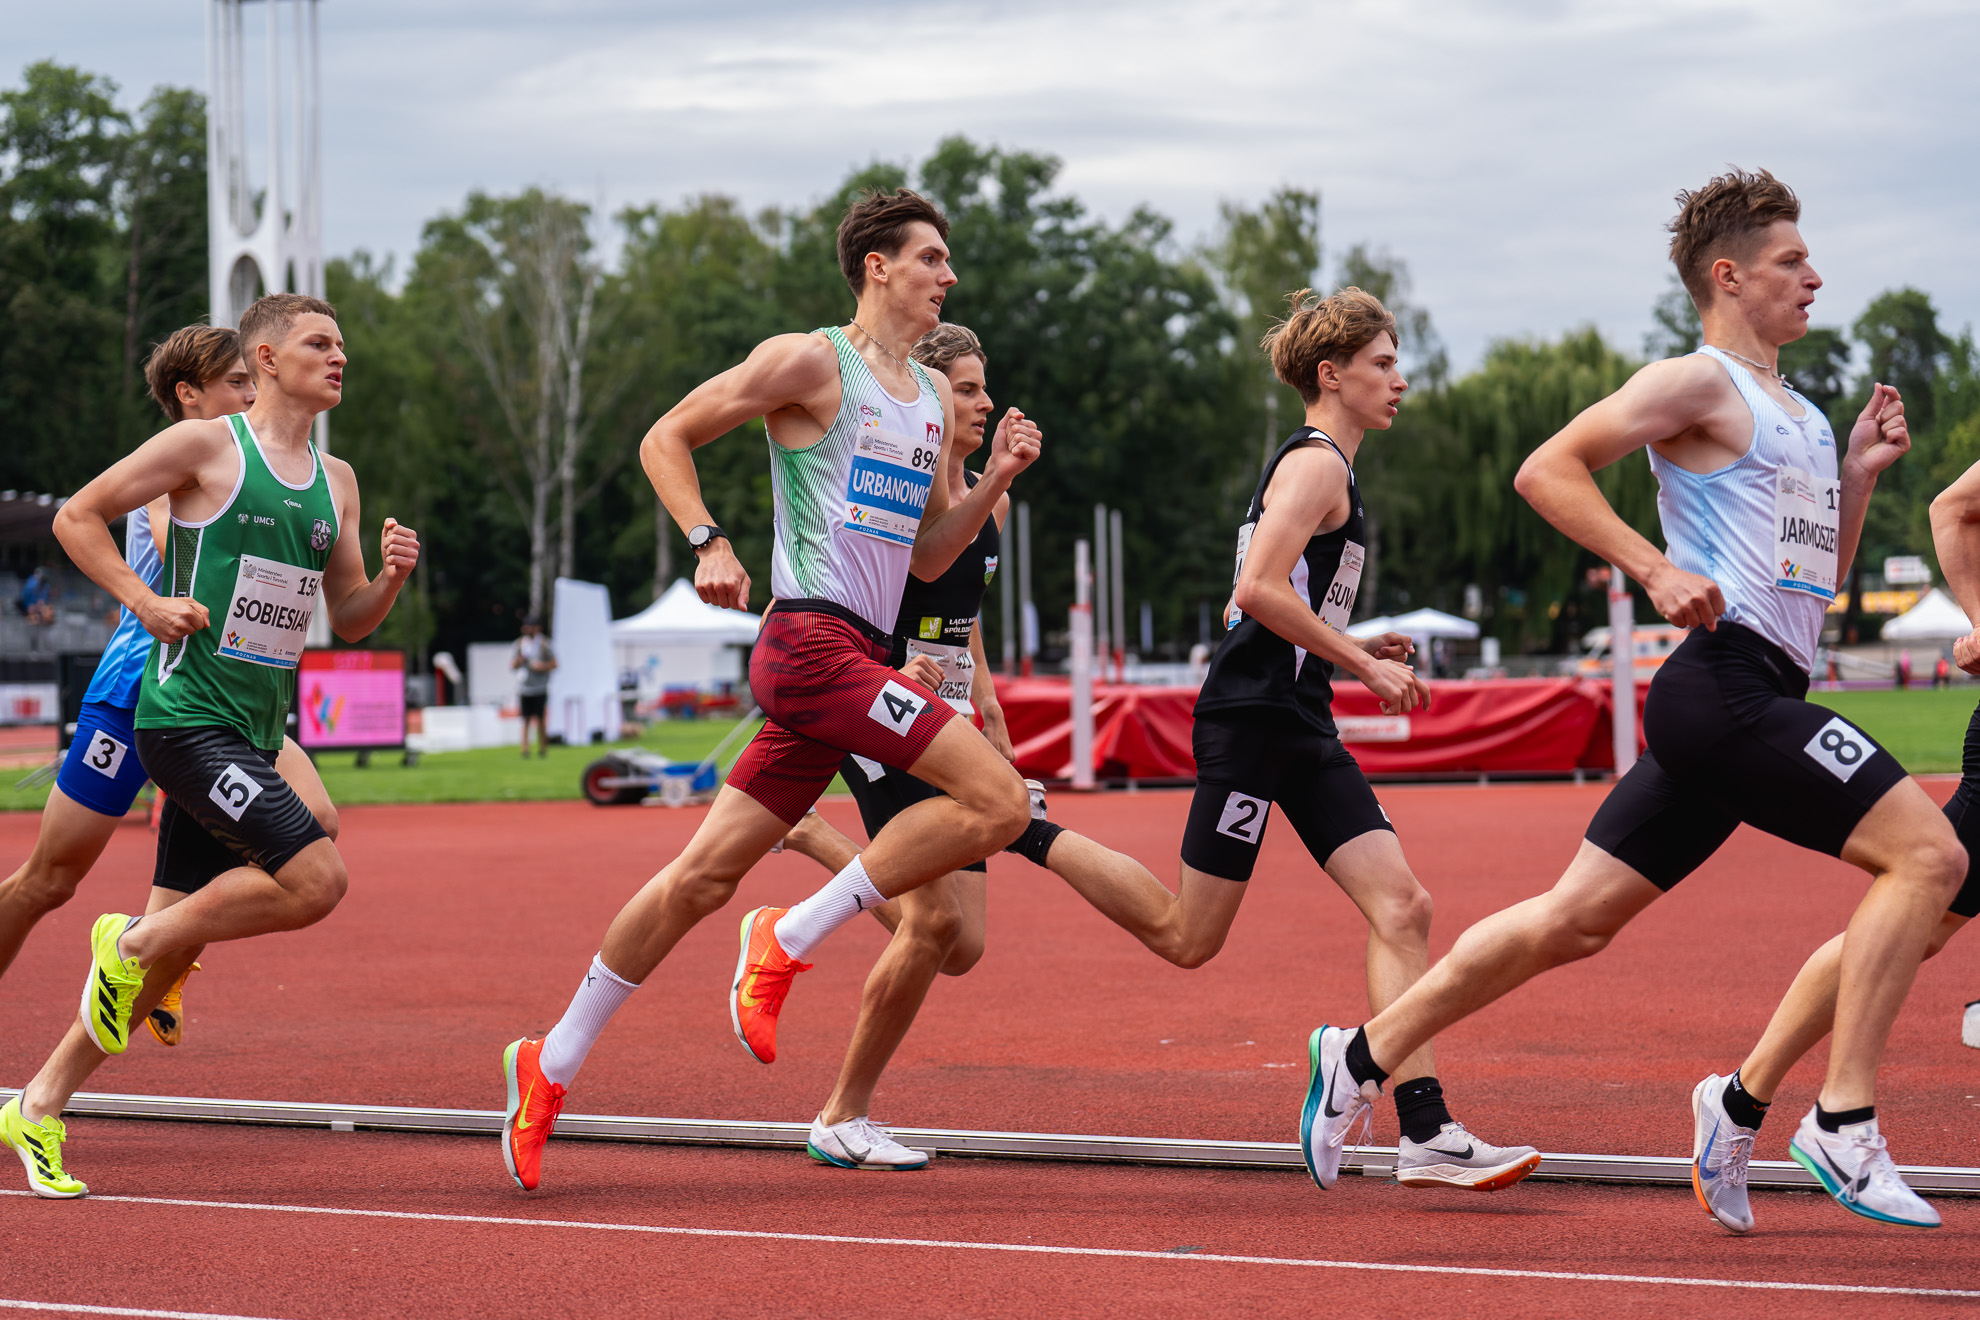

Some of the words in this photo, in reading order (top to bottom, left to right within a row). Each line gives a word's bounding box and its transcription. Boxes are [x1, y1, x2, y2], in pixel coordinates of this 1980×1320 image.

[253, 515, 275, 526] UMCS
[258, 567, 283, 577] Ministerstwo
[233, 596, 312, 633] SOBIESIAK
[882, 690, 917, 724] 4
[92, 738, 116, 769] 3
[1820, 729, 1862, 765] 8
[217, 773, 249, 808] 5
[1226, 799, 1258, 838] 2
